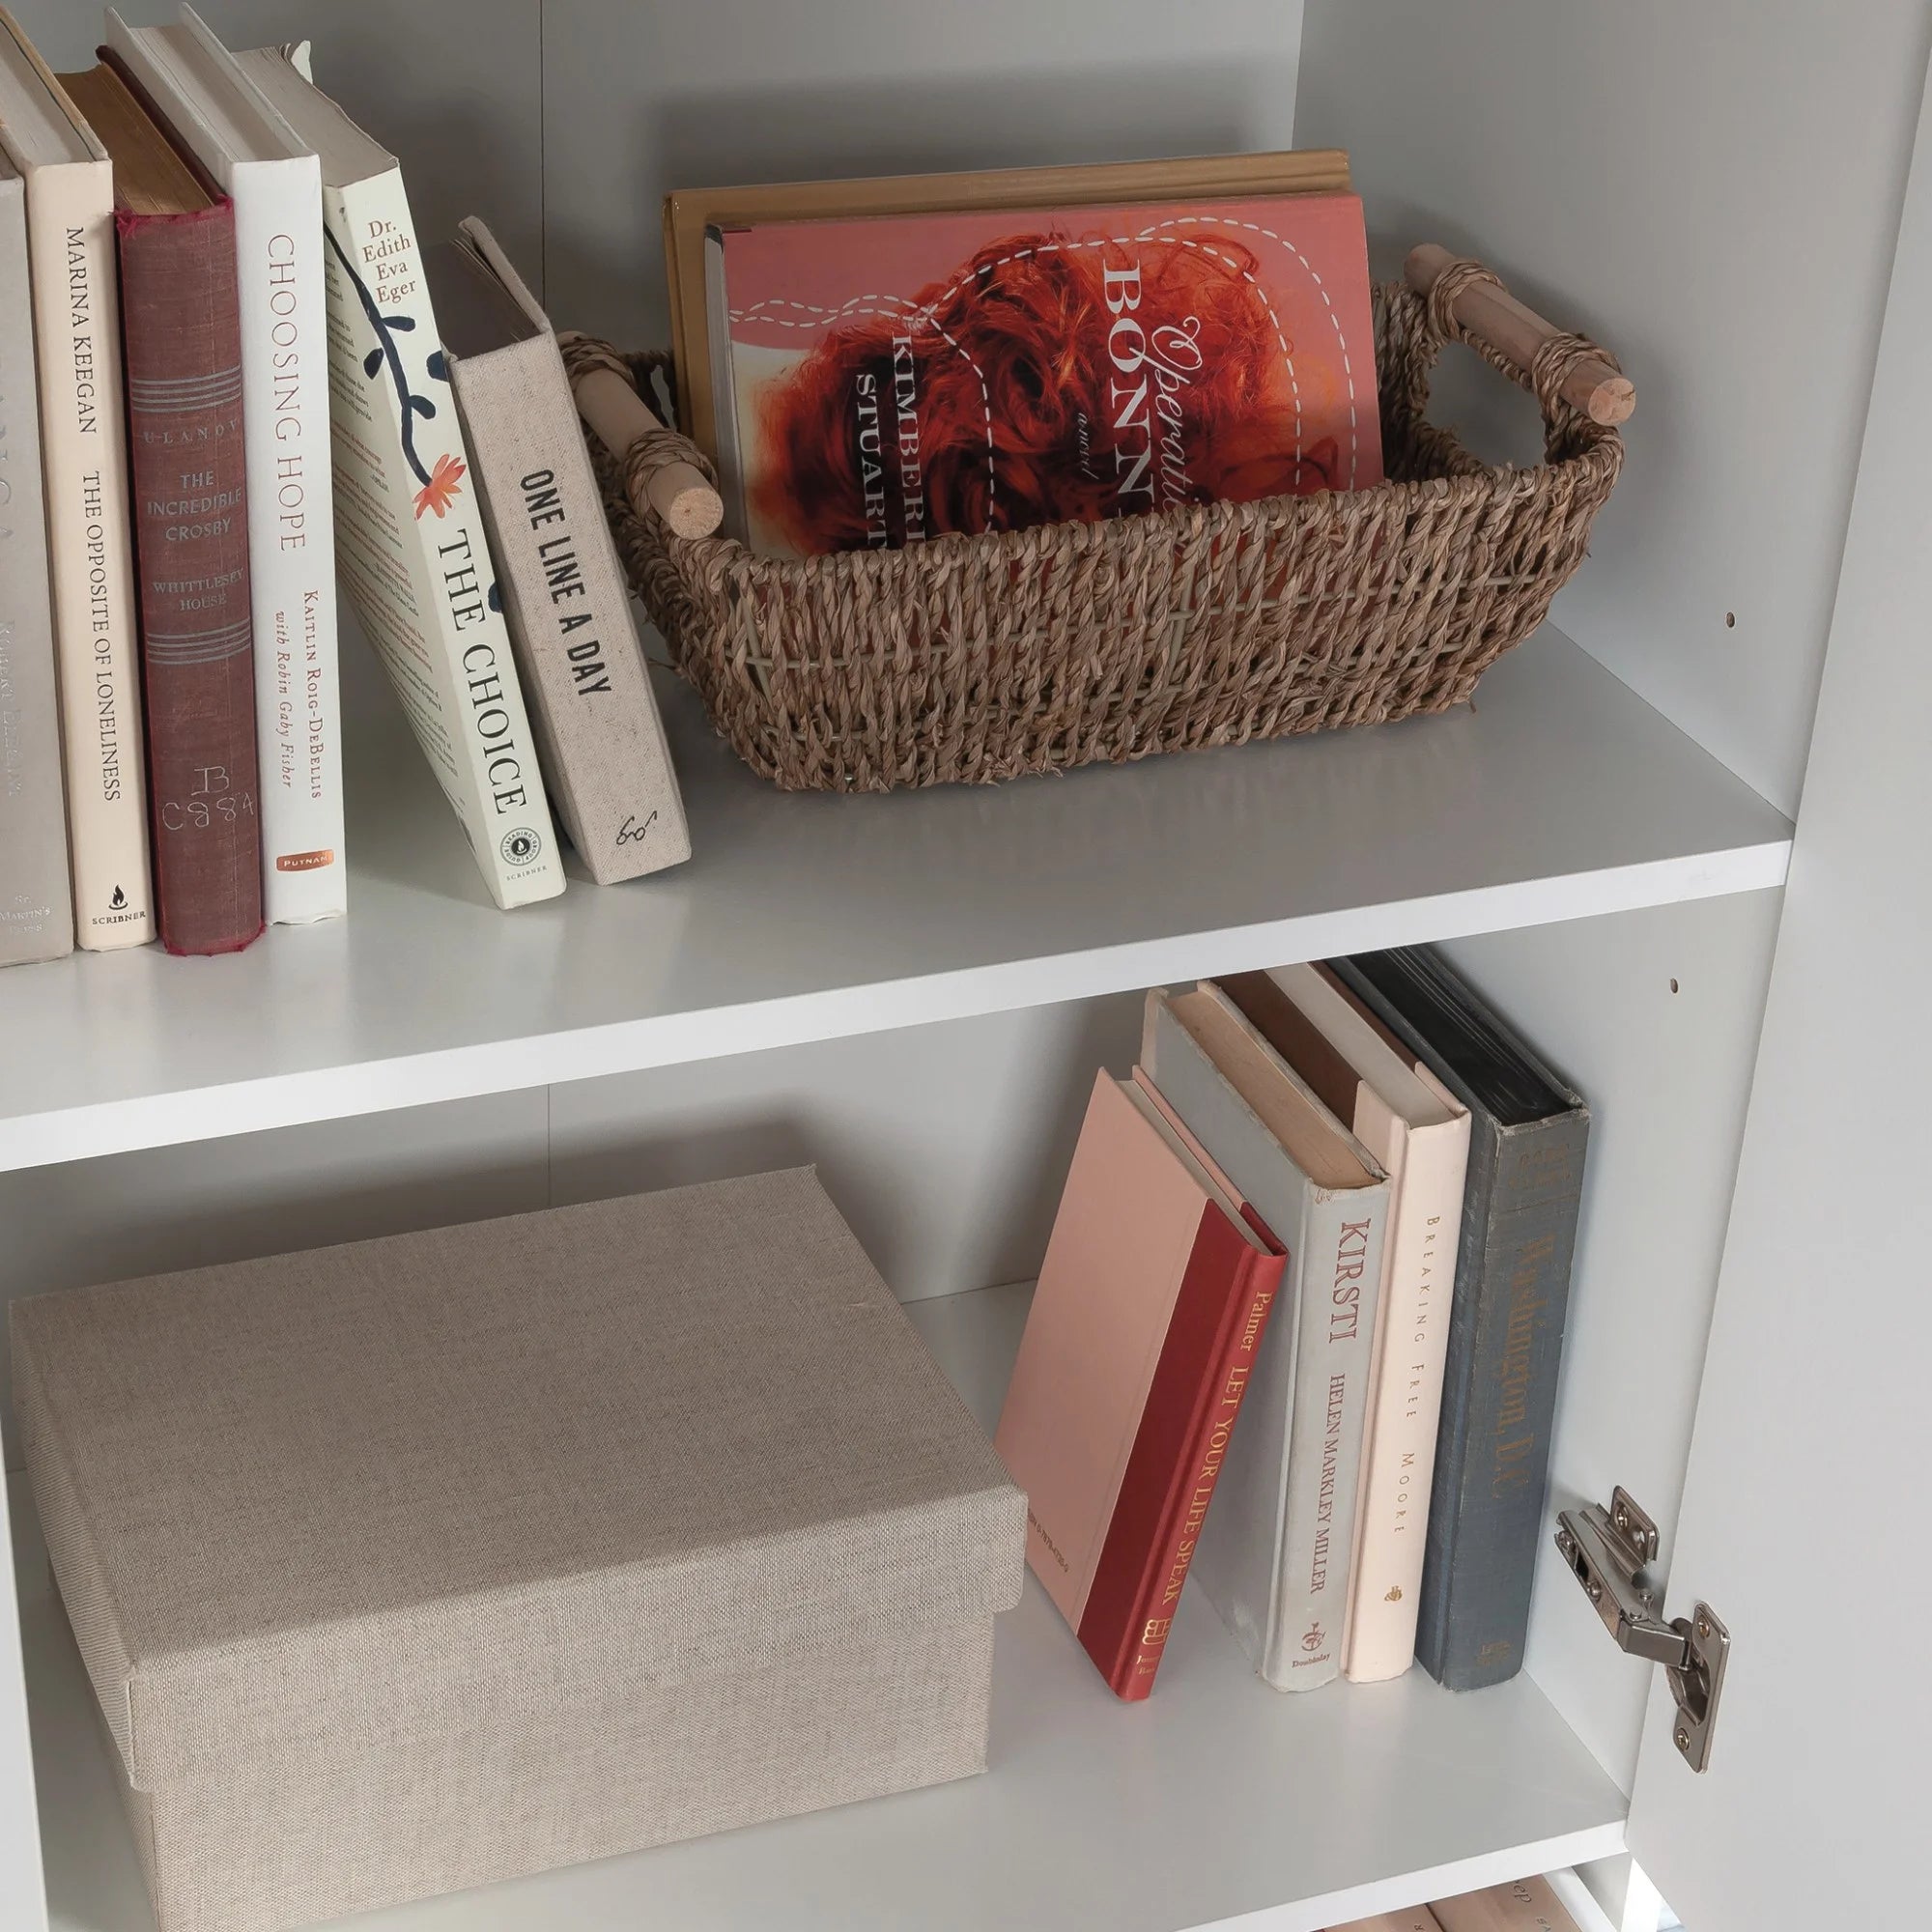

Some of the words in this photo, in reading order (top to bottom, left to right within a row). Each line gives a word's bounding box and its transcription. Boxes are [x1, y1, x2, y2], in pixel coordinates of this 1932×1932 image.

[362, 233, 412, 263] Edith
[368, 219, 397, 239] Dr.
[66, 227, 90, 328] MARINA
[376, 259, 409, 281] Eva
[376, 278, 417, 304] Eger
[268, 235, 301, 441] CHOOSING
[73, 335, 97, 434] KEEGAN
[1102, 259, 1155, 516] BONN
[892, 331, 926, 542] KIMBERL
[1152, 316, 1203, 511] Operati
[180, 470, 214, 488] THE
[855, 374, 888, 547] STUART
[82, 470, 102, 518] THE
[147, 487, 242, 516] INCREDIBLE
[277, 456, 305, 551] HOPE
[521, 469, 565, 530] ONE
[165, 517, 232, 541] CROSBY
[86, 524, 109, 633] OPPOSITE
[153, 568, 244, 594] WHITTLESEY
[538, 535, 585, 605] LINE
[180, 593, 228, 611] HOUSE
[275, 611, 290, 645] with
[303, 590, 319, 661] KAITLIN
[558, 612, 589, 635] A
[94, 639, 111, 665] OF
[276, 651, 292, 694] Robin
[438, 528, 486, 631] THE
[463, 643, 527, 815] CHOICE
[567, 639, 612, 696] DAY
[96, 672, 121, 802] LONELINESS
[276, 701, 293, 737] Gaby
[191, 766, 230, 796] B
[281, 743, 295, 788] Fisher
[283, 855, 328, 867] PUTNAM
[506, 866, 548, 881] SCRIBNER
[92, 911, 146, 925] SCRIBNER
[1328, 1218, 1372, 1345] KIRSTI
[1413, 1215, 1440, 1344] BREAKING
[1240, 1291, 1273, 1352] Palmer
[1221, 1366, 1249, 1408] LET
[1326, 1373, 1346, 1435] HELEN
[1406, 1364, 1425, 1418] FREE
[1198, 1418, 1234, 1481] YOUR
[1317, 1436, 1340, 1523] MARKLEY
[1394, 1452, 1415, 1533] MOORE
[1183, 1487, 1211, 1535] LIFE
[1162, 1539, 1195, 1605] SPEAK
[1310, 1527, 1330, 1595] MILLER
